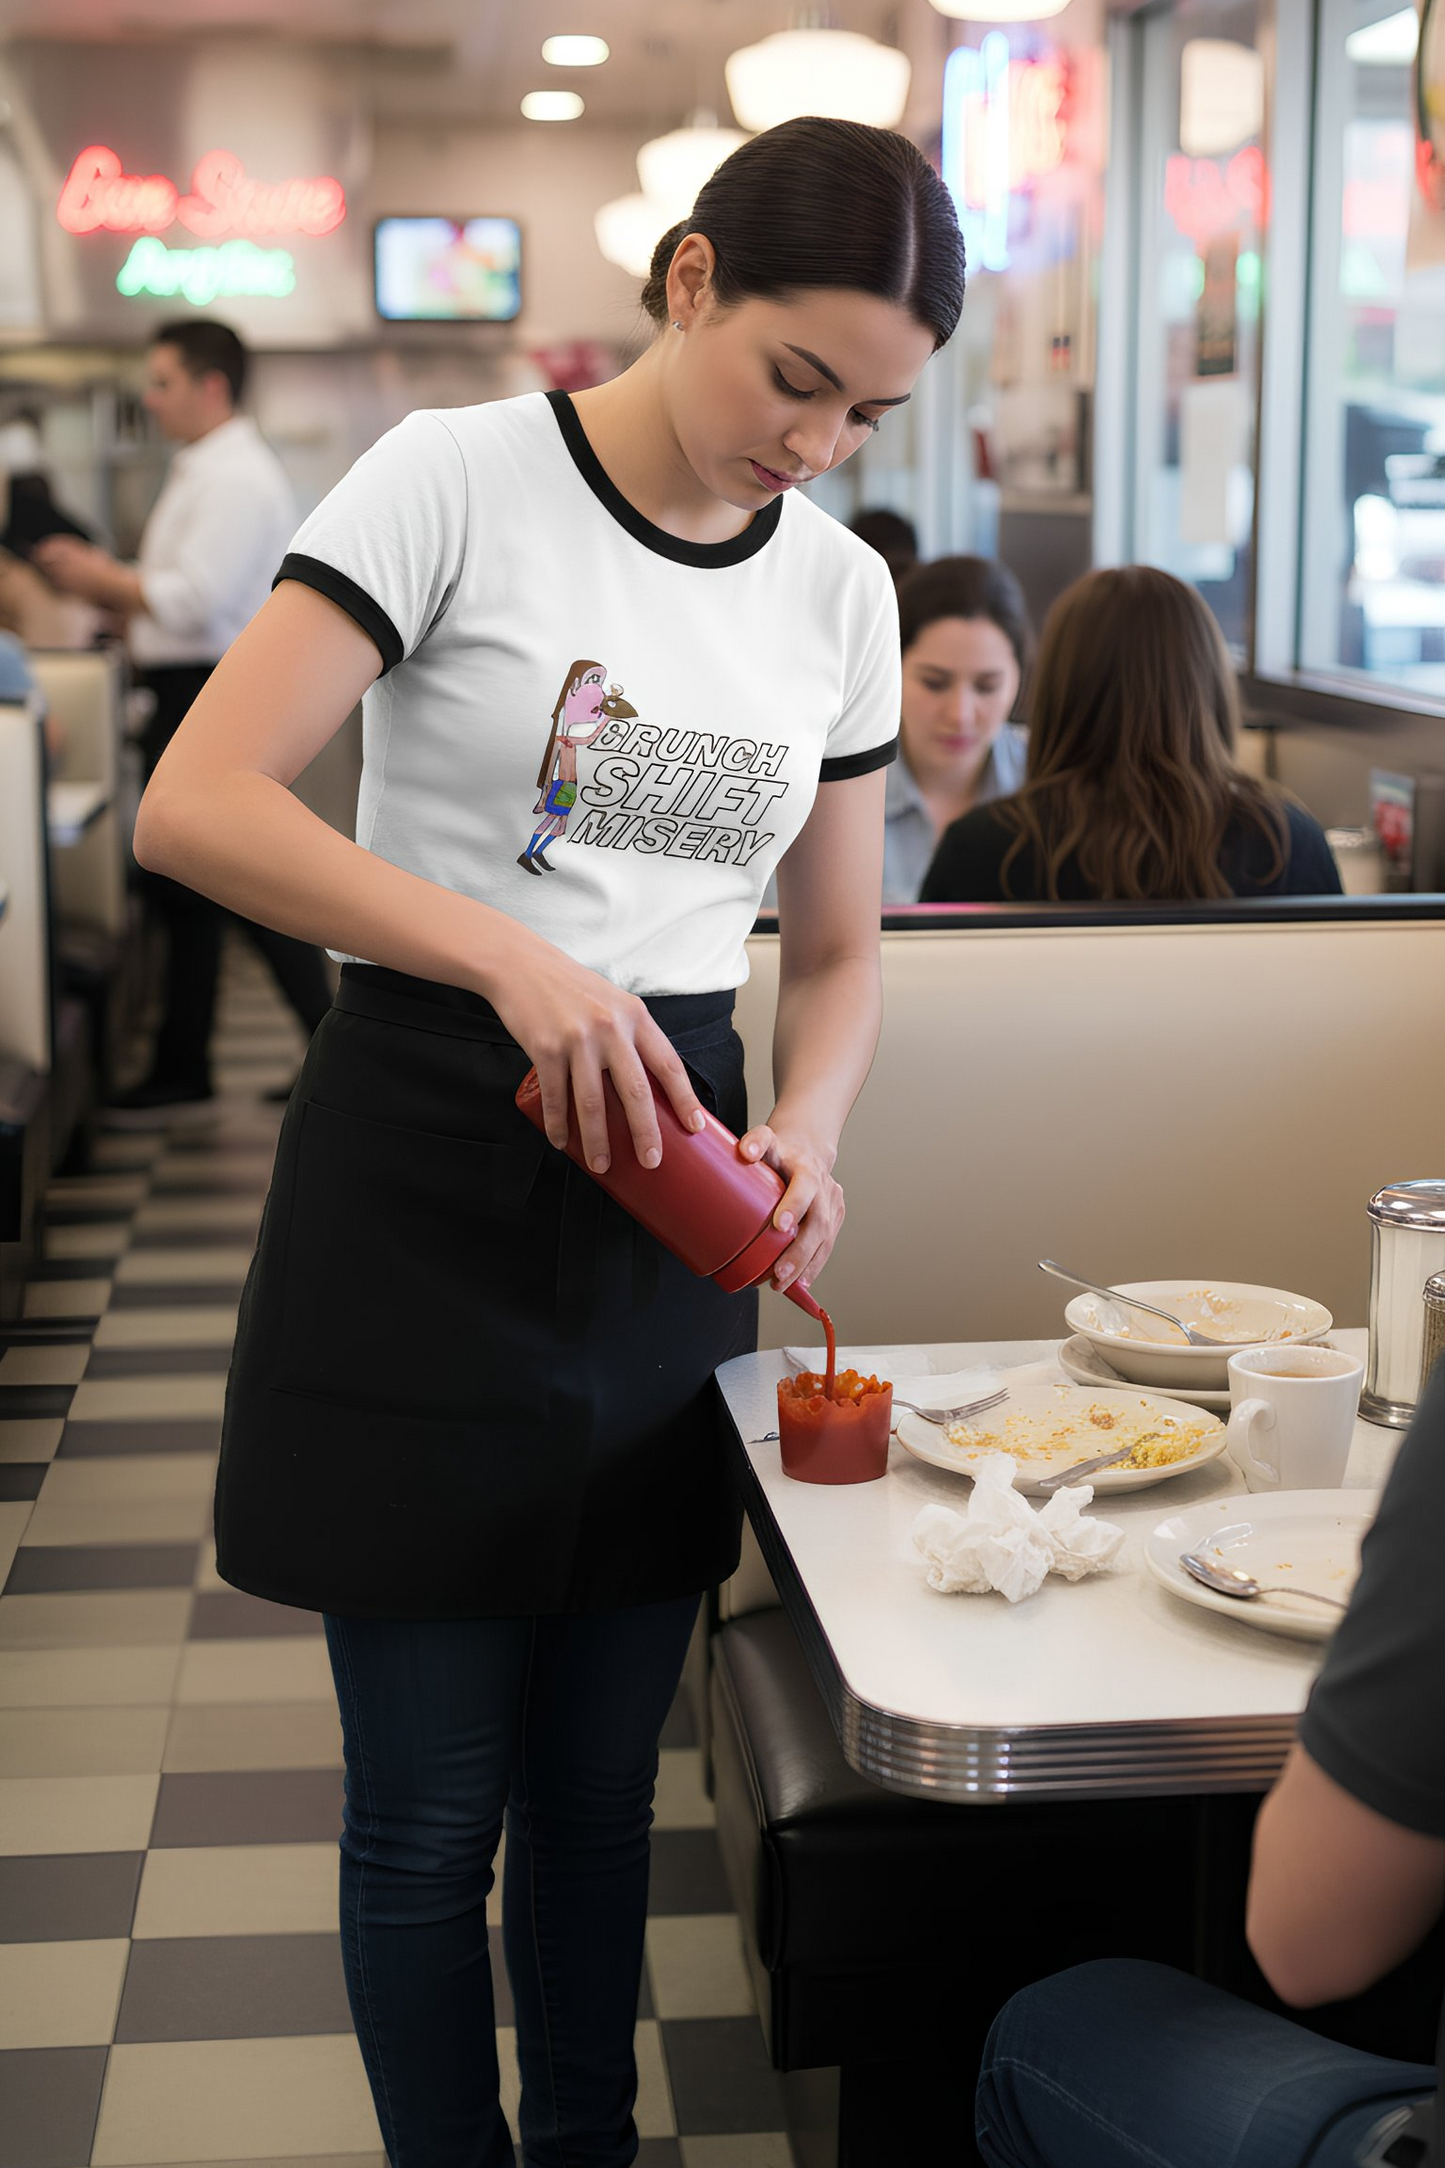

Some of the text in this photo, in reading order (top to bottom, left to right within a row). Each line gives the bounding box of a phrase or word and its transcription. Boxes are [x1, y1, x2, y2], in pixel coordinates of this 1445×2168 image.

[587, 719, 789, 777] BRUNCH
[580, 757, 789, 826] SHIFT
[567, 809, 775, 866] MISERY
